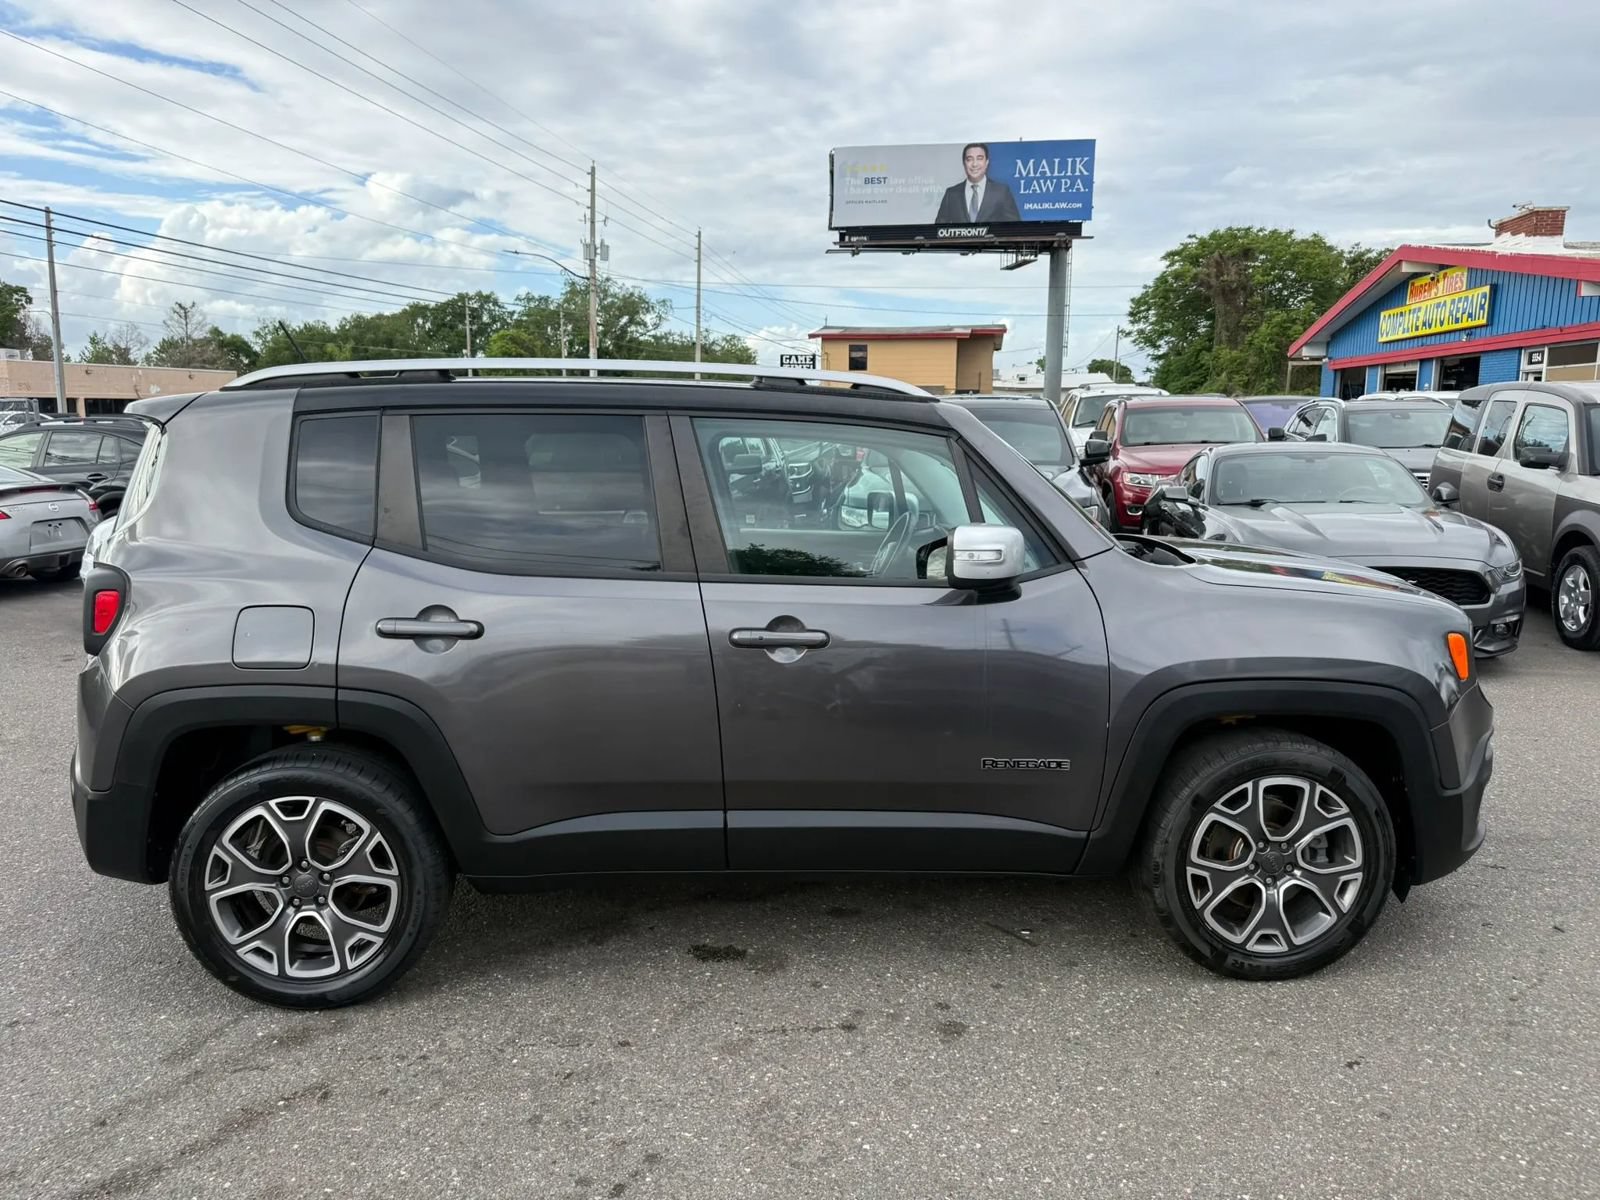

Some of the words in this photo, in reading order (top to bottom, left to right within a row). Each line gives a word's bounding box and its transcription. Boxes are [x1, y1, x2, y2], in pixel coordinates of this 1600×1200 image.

[1014, 157, 1090, 178] MALIK
[864, 177, 888, 185] BEST
[1019, 179, 1057, 194] LAW
[1060, 178, 1089, 193] P.A.
[1380, 306, 1422, 338] COMPLETE
[1421, 300, 1447, 330] AUTO
[1448, 291, 1488, 326] REPAIR
[782, 355, 813, 364] GAME
[981, 757, 1070, 771] RENEGADE
